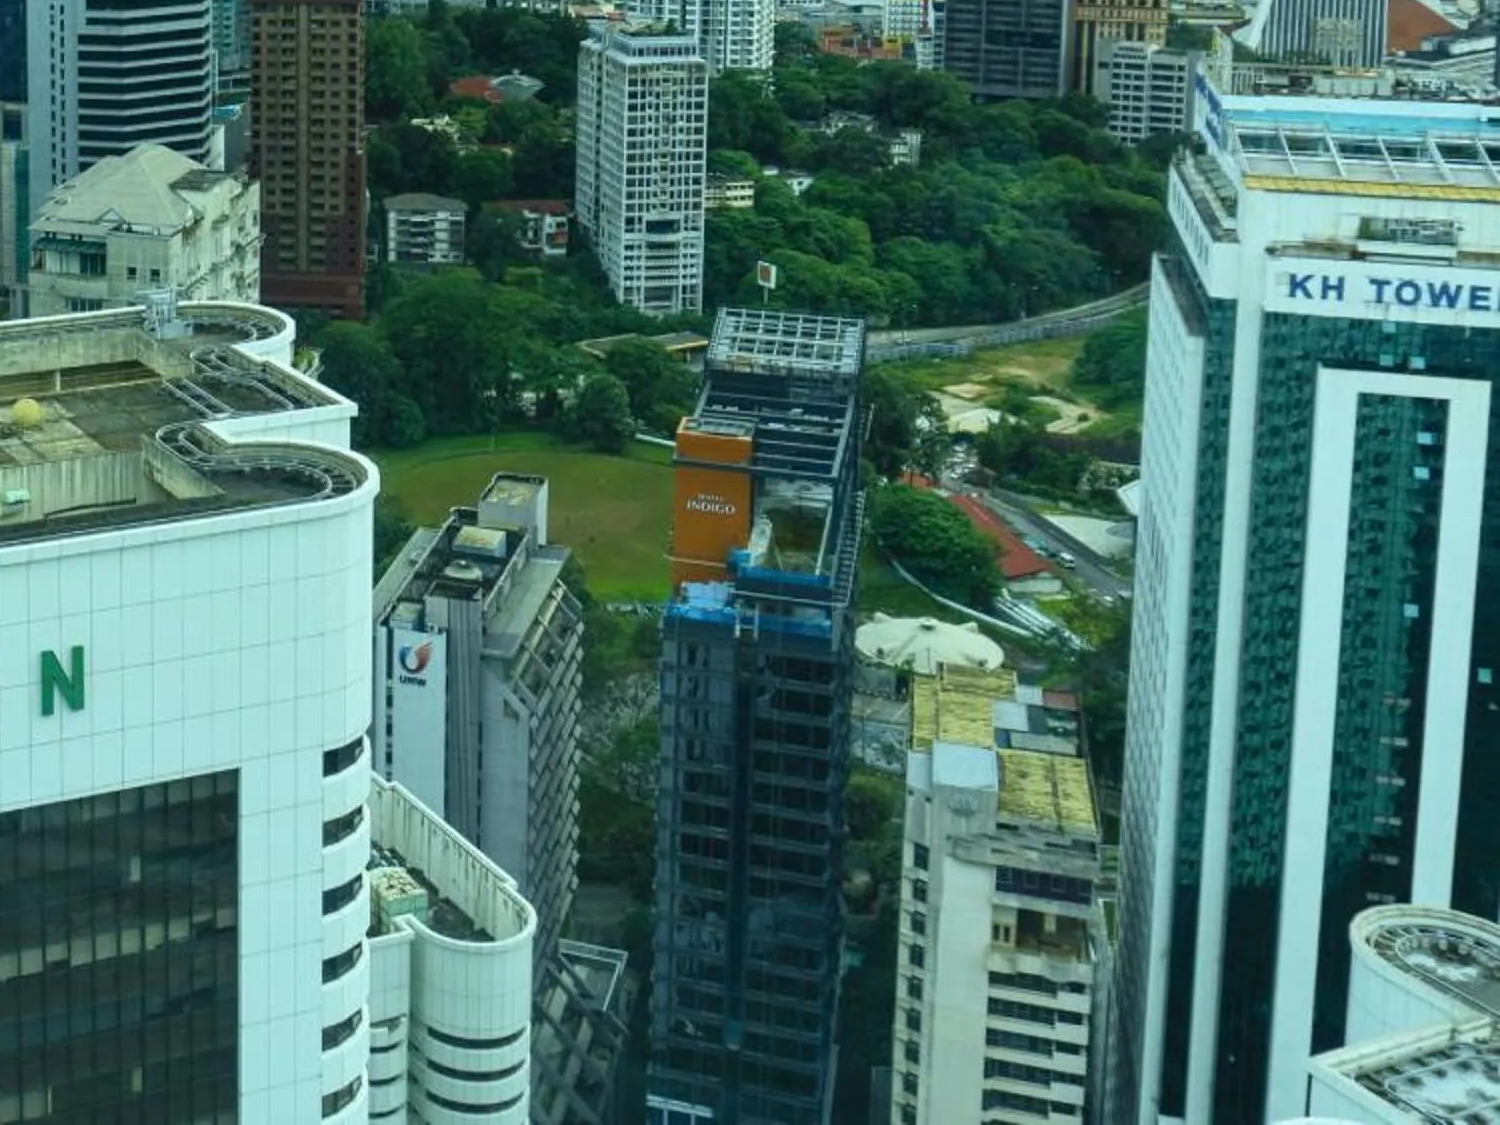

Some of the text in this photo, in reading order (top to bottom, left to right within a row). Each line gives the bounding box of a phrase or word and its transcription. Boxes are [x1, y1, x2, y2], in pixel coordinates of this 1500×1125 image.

[1289, 274, 1500, 312] KH TOWE
[686, 498, 737, 516] INDIGO
